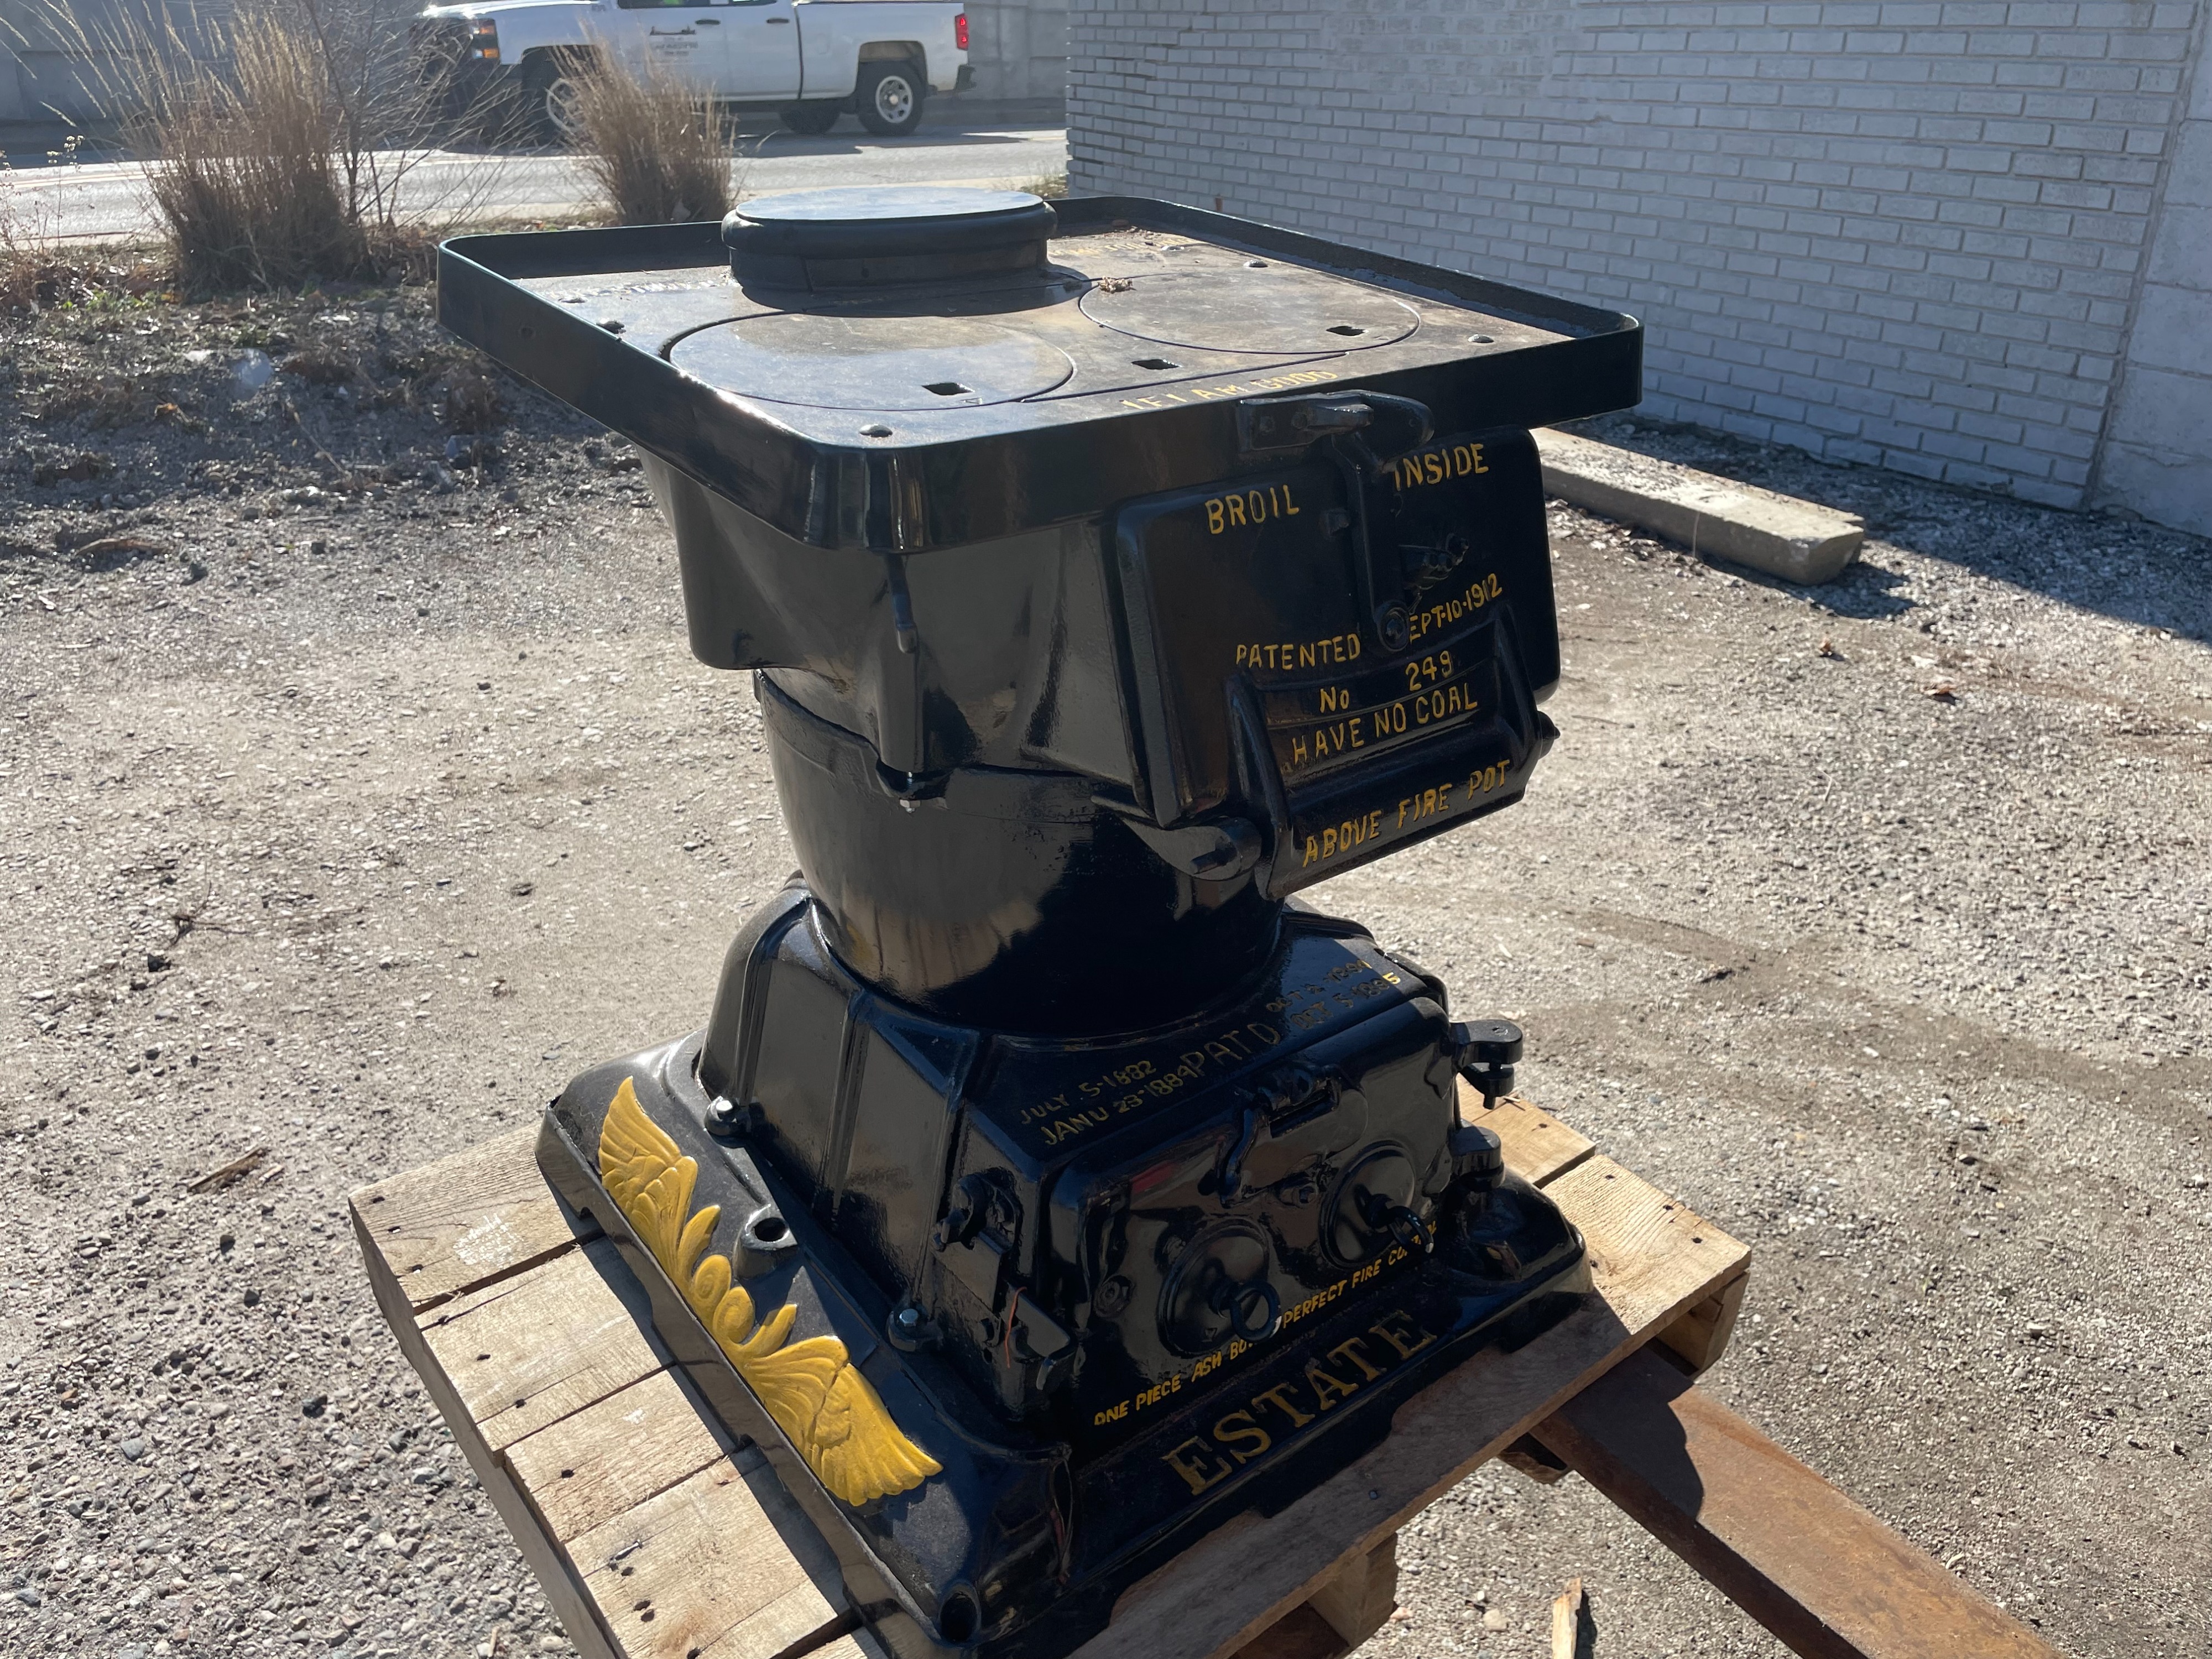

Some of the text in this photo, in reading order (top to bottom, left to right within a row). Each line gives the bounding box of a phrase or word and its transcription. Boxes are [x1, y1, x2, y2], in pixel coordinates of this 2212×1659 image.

[1191, 384, 1253, 399] AM
[1249, 370, 1338, 390] GOOD
[1204, 443, 1489, 535] BROIL INSIDE
[1235, 633, 1361, 670] PATENTED
[1405, 650, 1454, 692] 249
[1292, 682, 1478, 765] HAVE NO COAL
[1302, 759, 1510, 868] ABOVE FIRE POT
[1020, 1093, 1071, 1125] JULY
[1040, 1105, 1110, 1146] JANU
[1094, 1401, 1129, 1426] ONE
[1135, 1373, 1182, 1411] PIECE
[1191, 1350, 1222, 1383] ASH
[1282, 1279, 1348, 1329] PERFECT
[1351, 1259, 1381, 1290] FIRE
[1161, 1308, 1438, 1496] ESTATE
